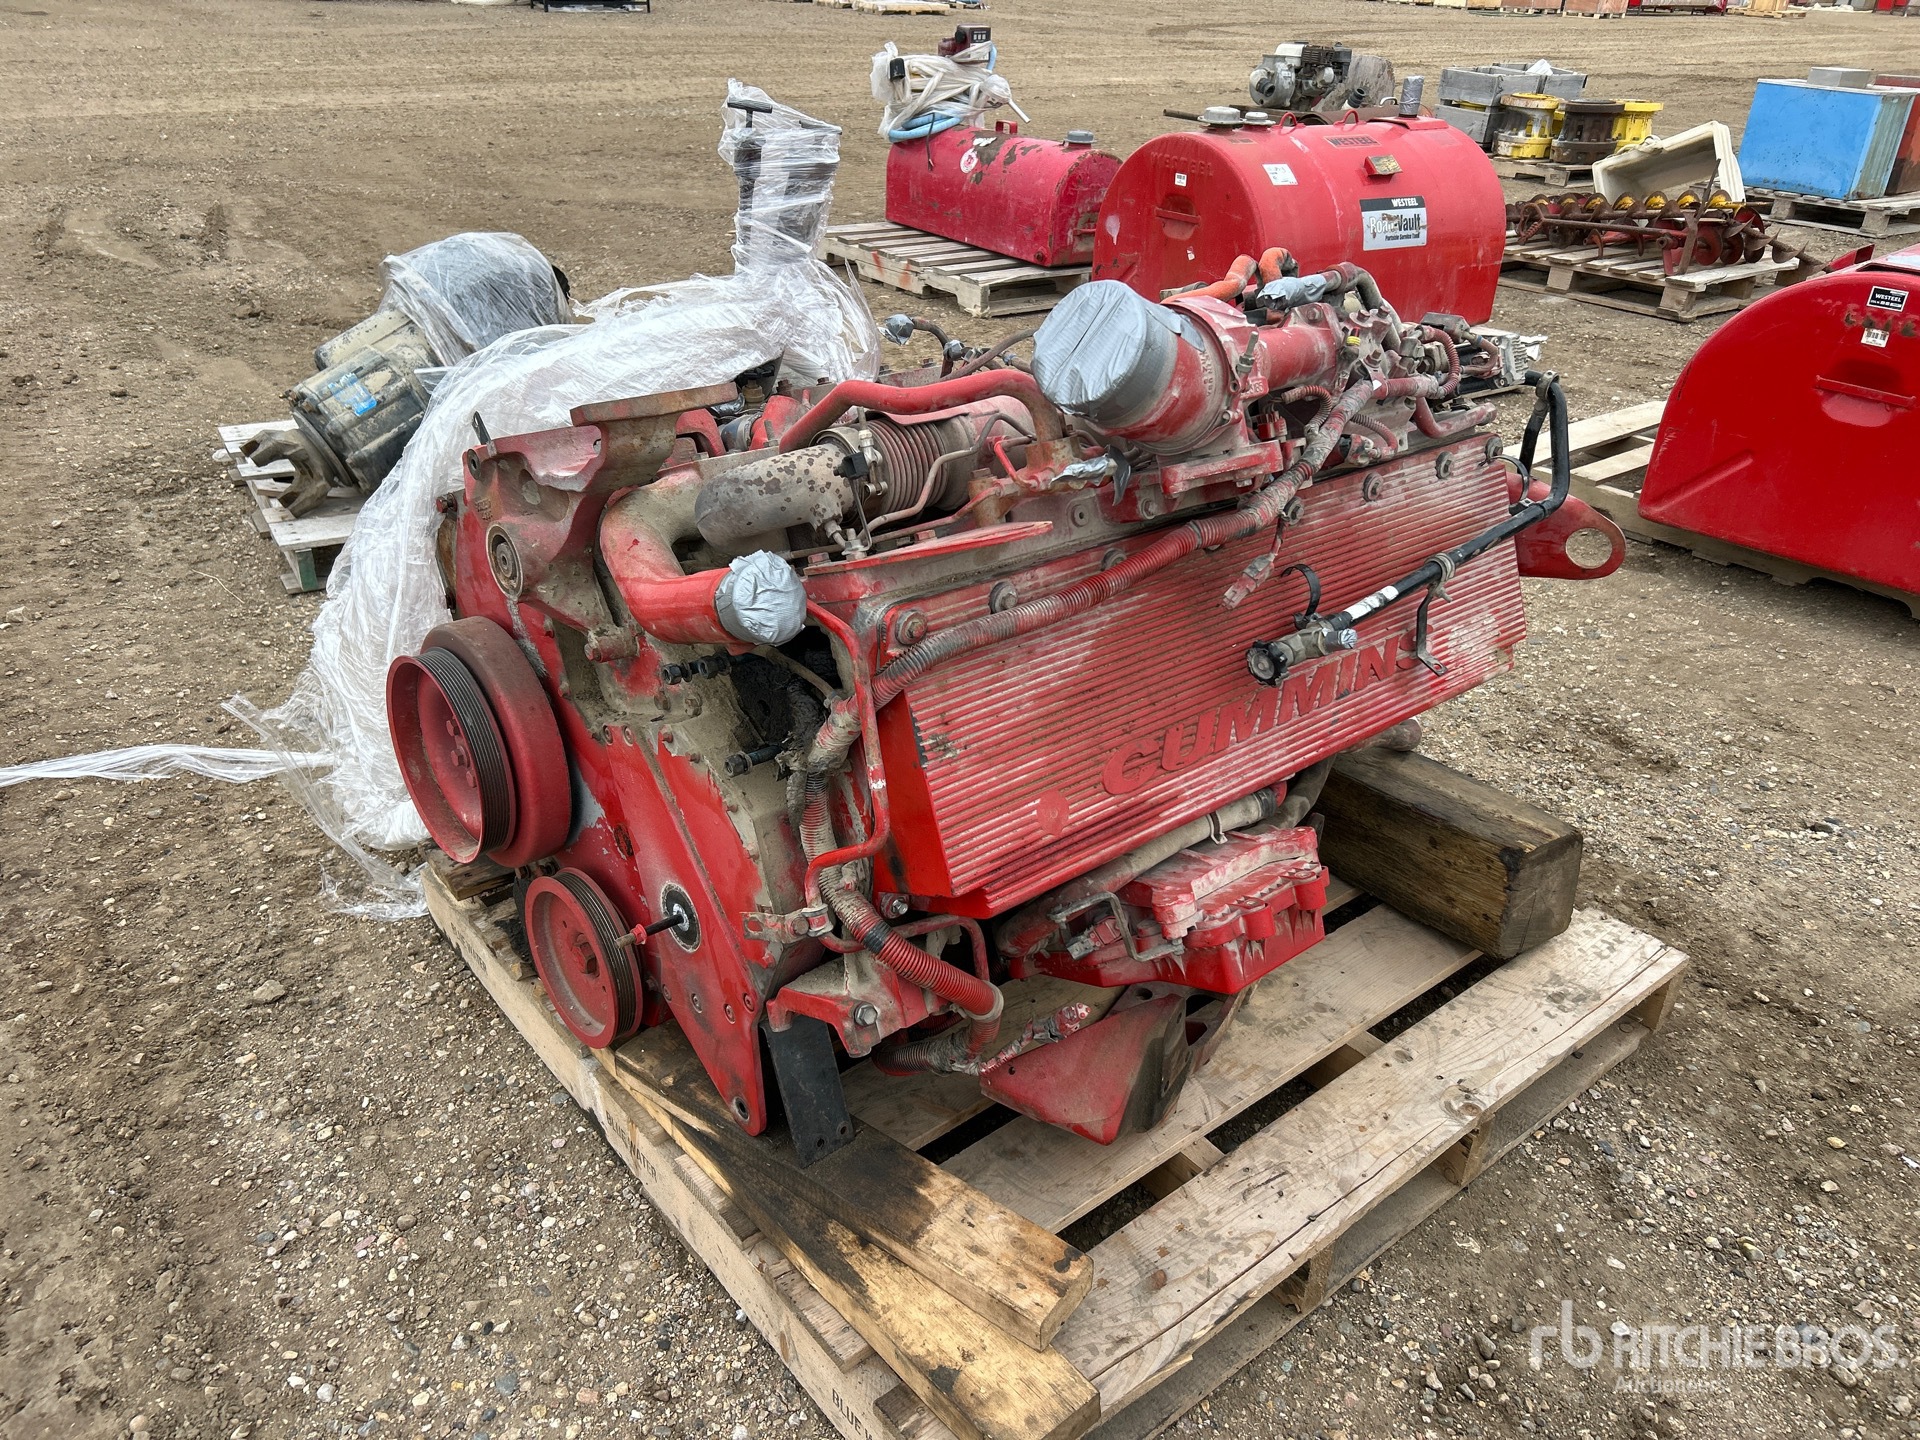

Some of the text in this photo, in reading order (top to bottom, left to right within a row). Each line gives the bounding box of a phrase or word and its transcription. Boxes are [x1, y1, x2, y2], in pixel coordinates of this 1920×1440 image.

[1391, 197, 1419, 208] WESTEEL
[1875, 293, 1902, 303] WESTEEL
[1102, 623, 1434, 795] CUMMINS
[606, 1110, 658, 1184] BLUE WATER
[832, 1388, 862, 1436] BLUE
